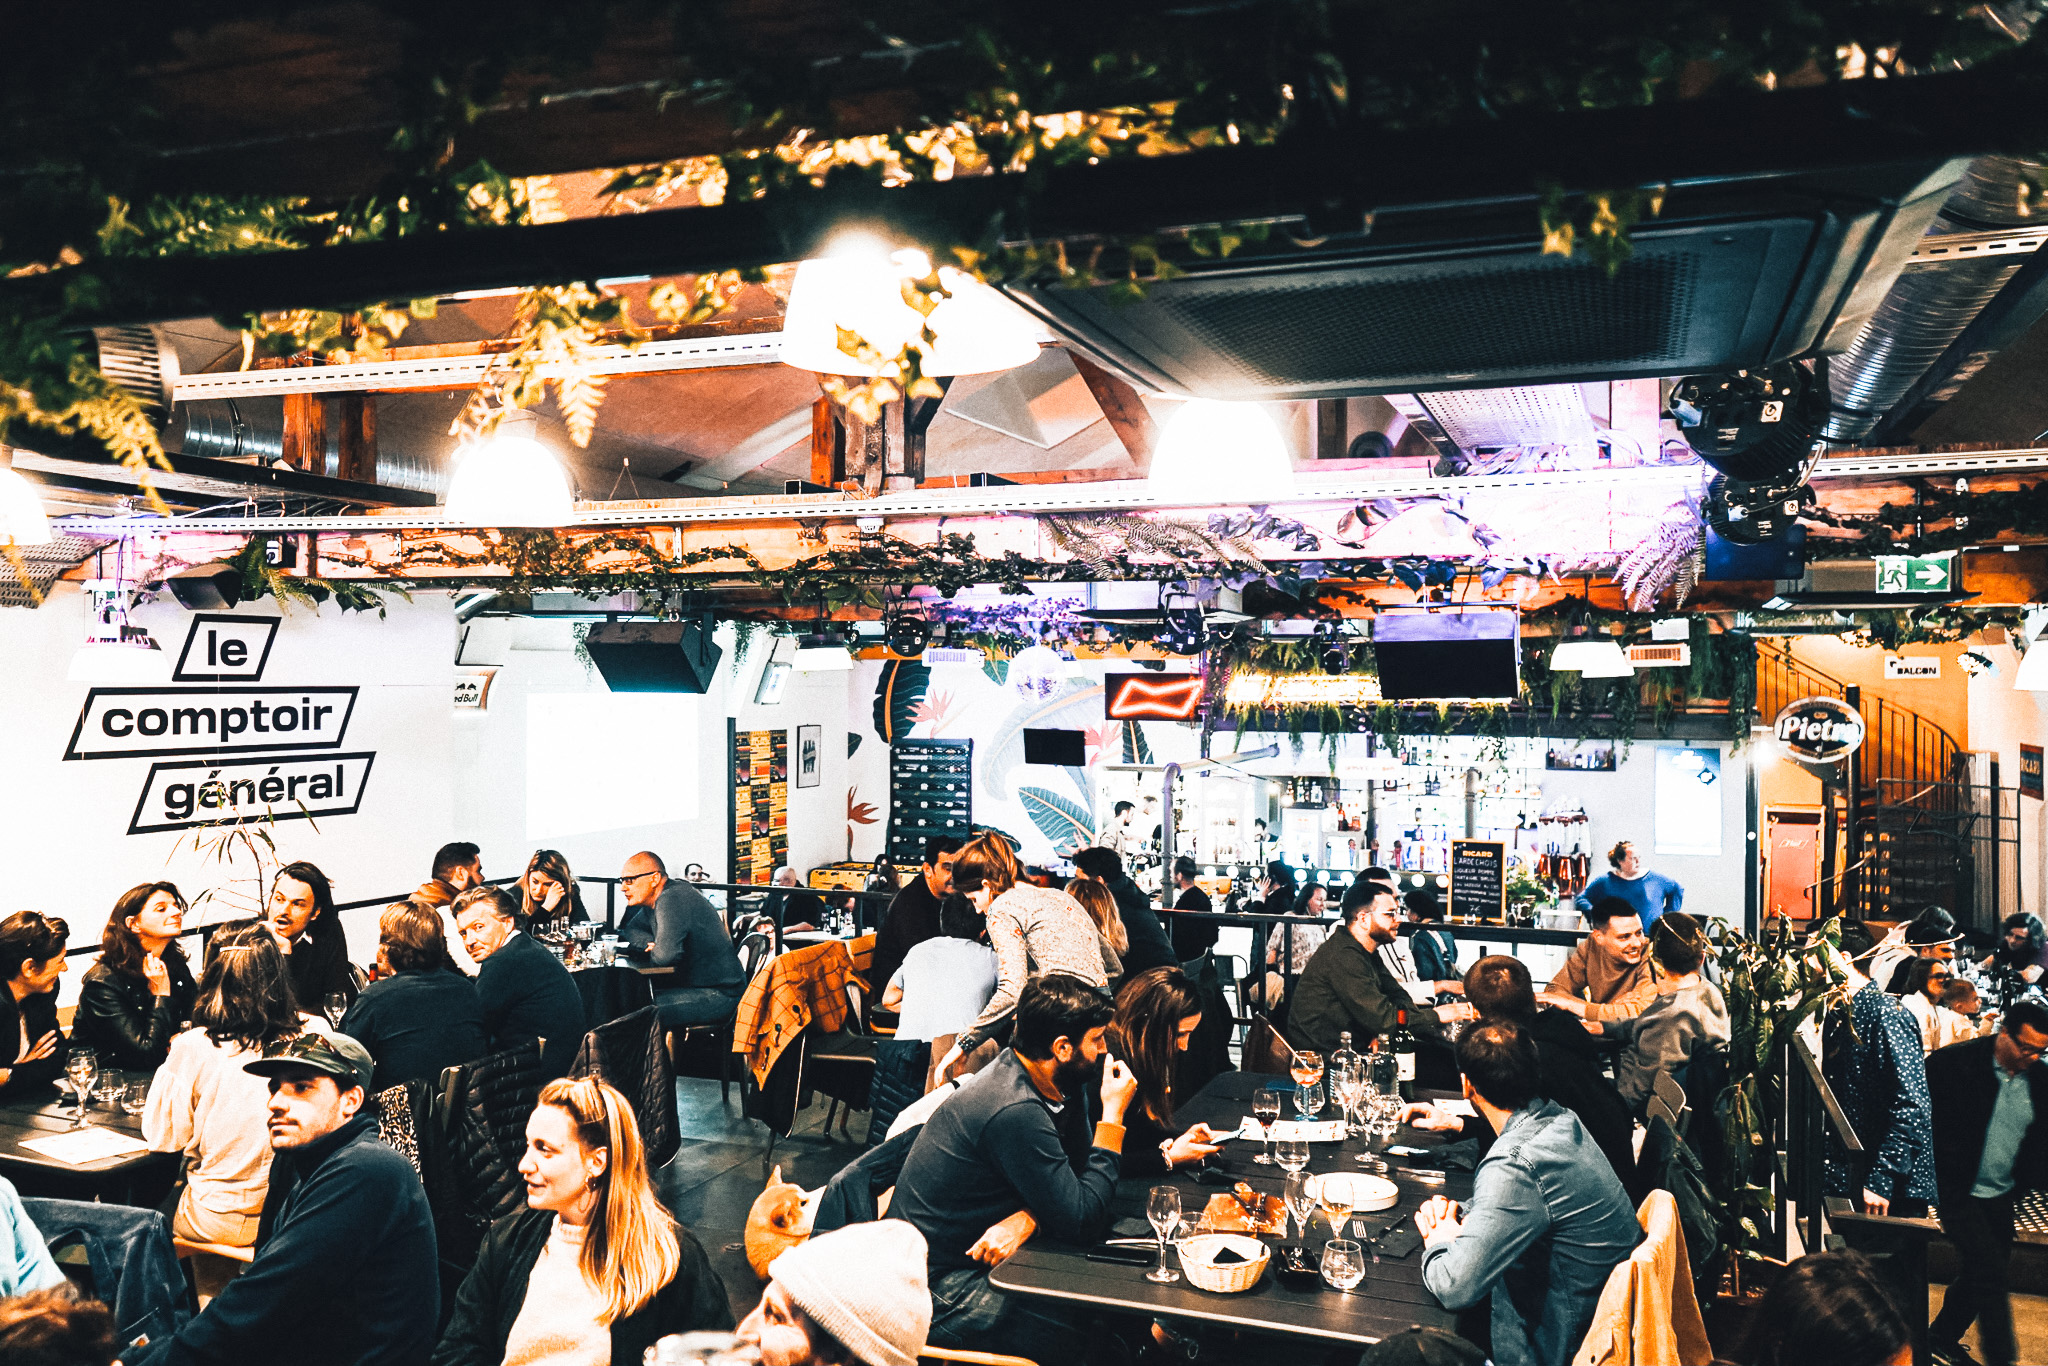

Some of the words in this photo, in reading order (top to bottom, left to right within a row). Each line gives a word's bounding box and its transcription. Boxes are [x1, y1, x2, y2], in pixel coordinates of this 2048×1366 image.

[207, 630, 248, 666] le
[1897, 667, 1937, 675] BALCON
[463, 694, 479, 702] Bull
[102, 697, 332, 742] comptoir
[164, 764, 343, 819] général
[1462, 850, 1494, 858] RICARD
